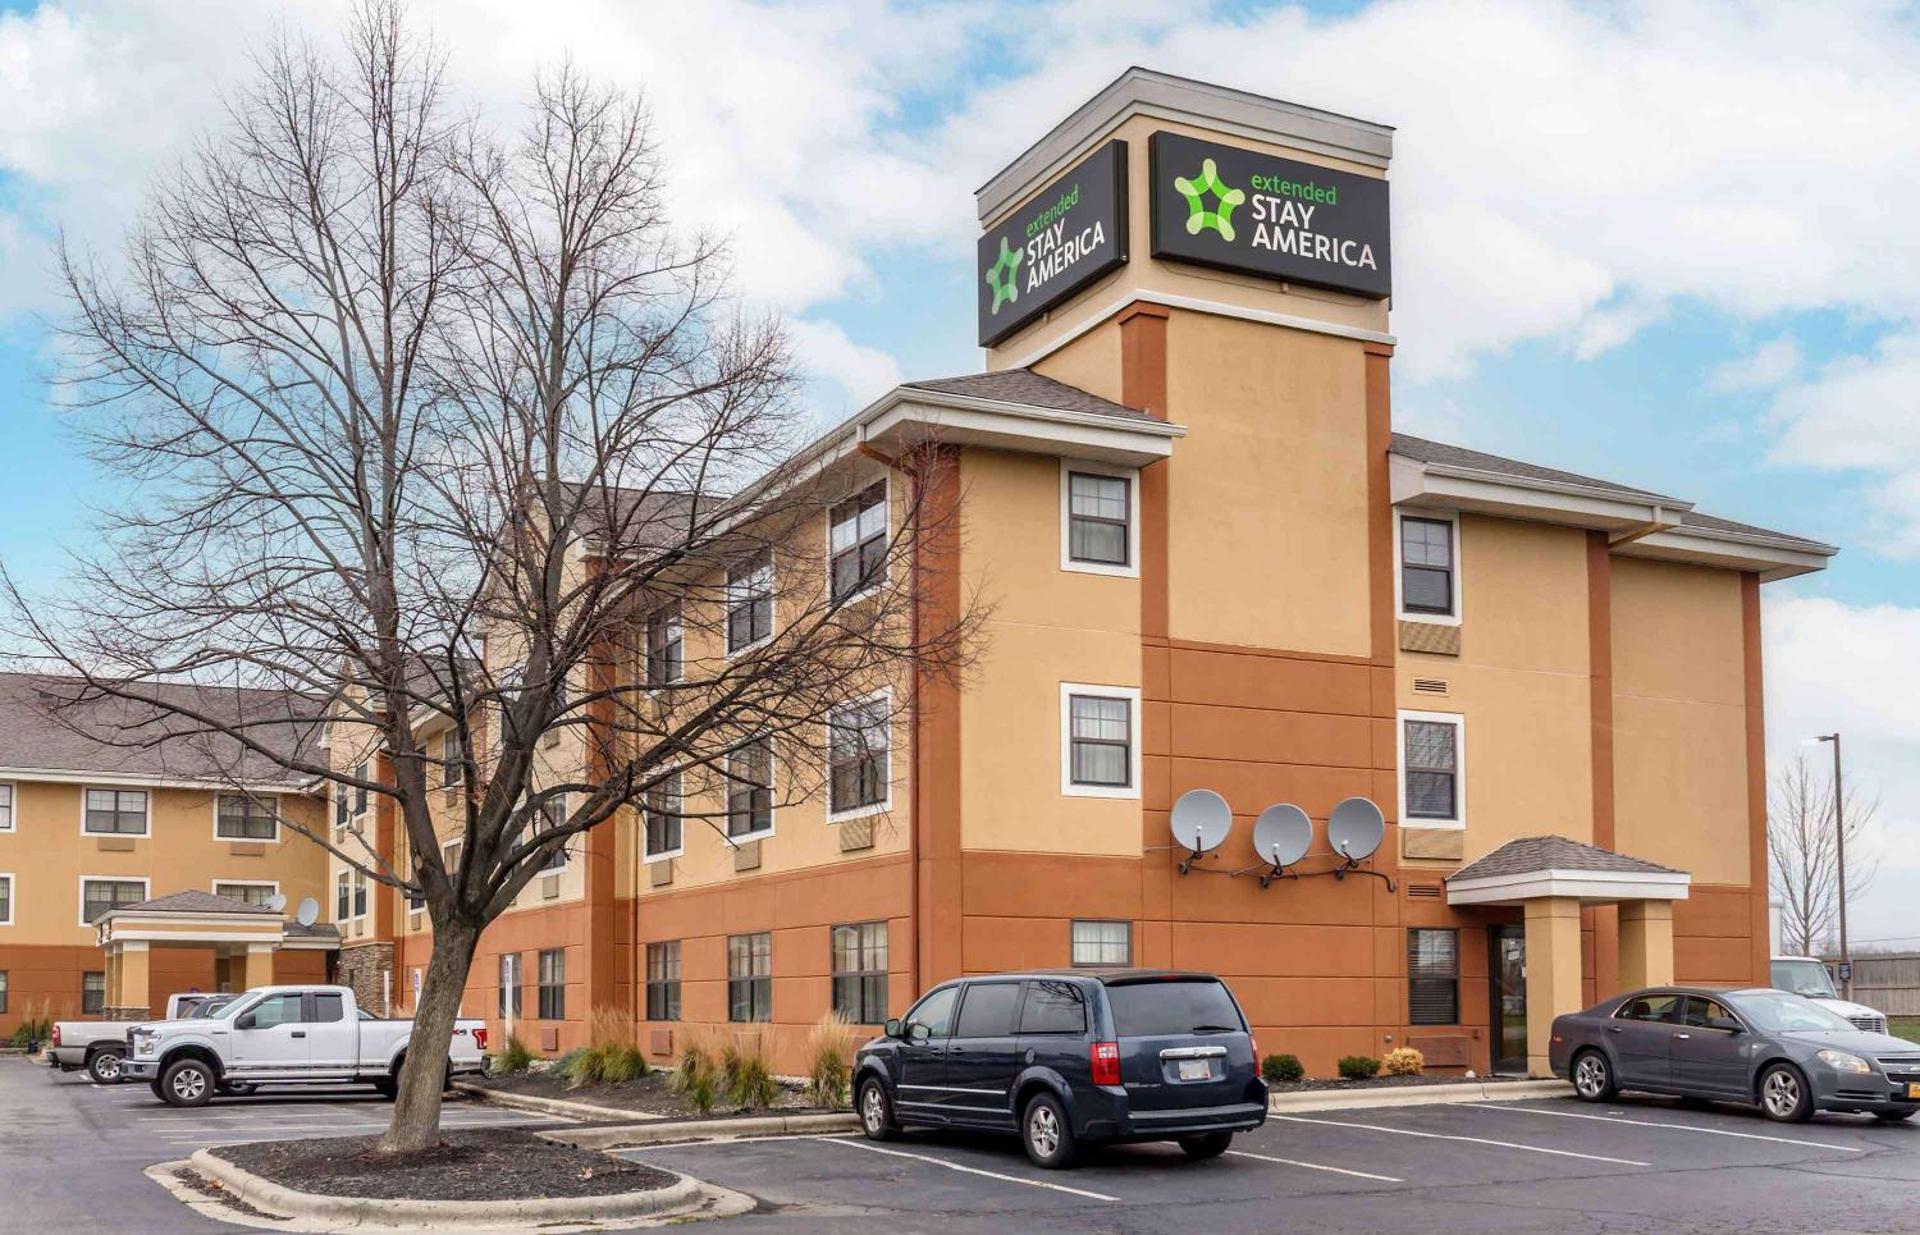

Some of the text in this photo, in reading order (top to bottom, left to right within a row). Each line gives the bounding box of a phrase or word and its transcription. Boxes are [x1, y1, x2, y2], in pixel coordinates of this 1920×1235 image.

[1026, 184, 1078, 237] extended
[1251, 174, 1336, 205] extended
[1252, 194, 1315, 229] STAY
[1026, 220, 1105, 294] AMERICA
[1027, 217, 1065, 266] STAY
[1251, 222, 1377, 270] AMERICA
